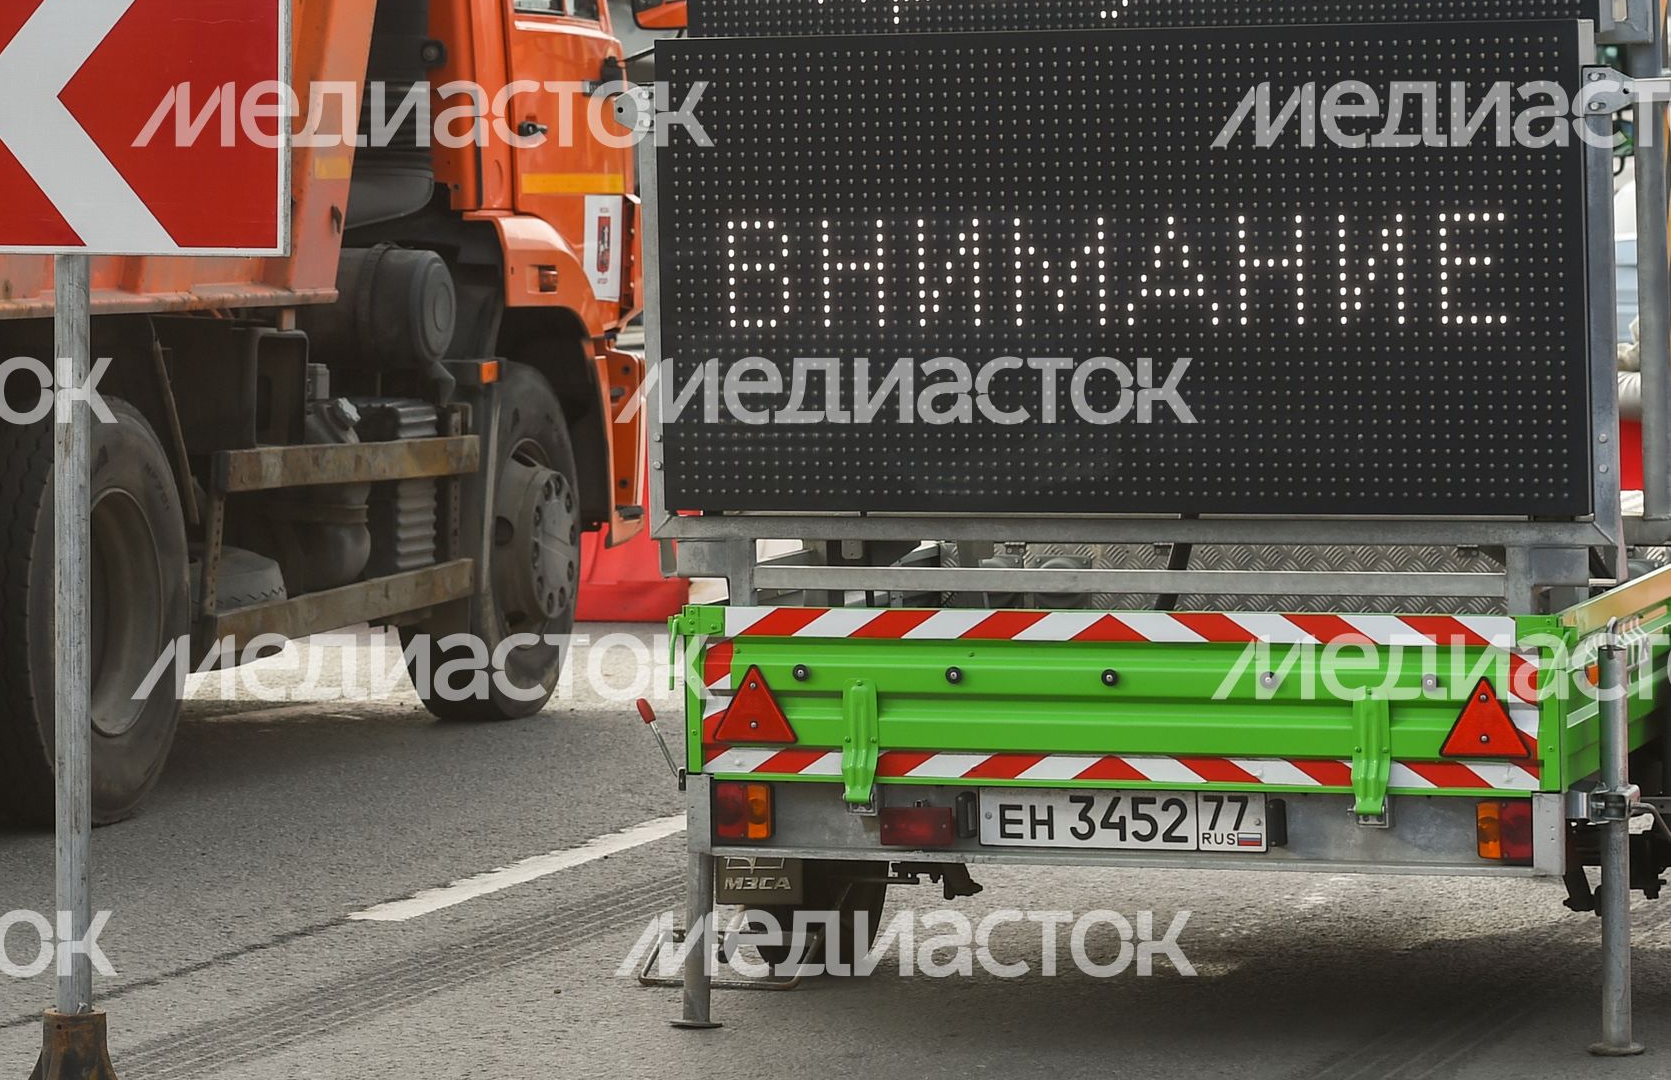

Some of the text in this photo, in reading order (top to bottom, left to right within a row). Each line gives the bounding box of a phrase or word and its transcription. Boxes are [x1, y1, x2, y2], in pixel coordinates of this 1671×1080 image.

[727, 213, 1509, 327] ВНИМАНИЕ
[999, 795, 1249, 843] ЕН 3452 77
[1201, 832, 1236, 846] RUS
[724, 876, 792, 890] МЗСА
